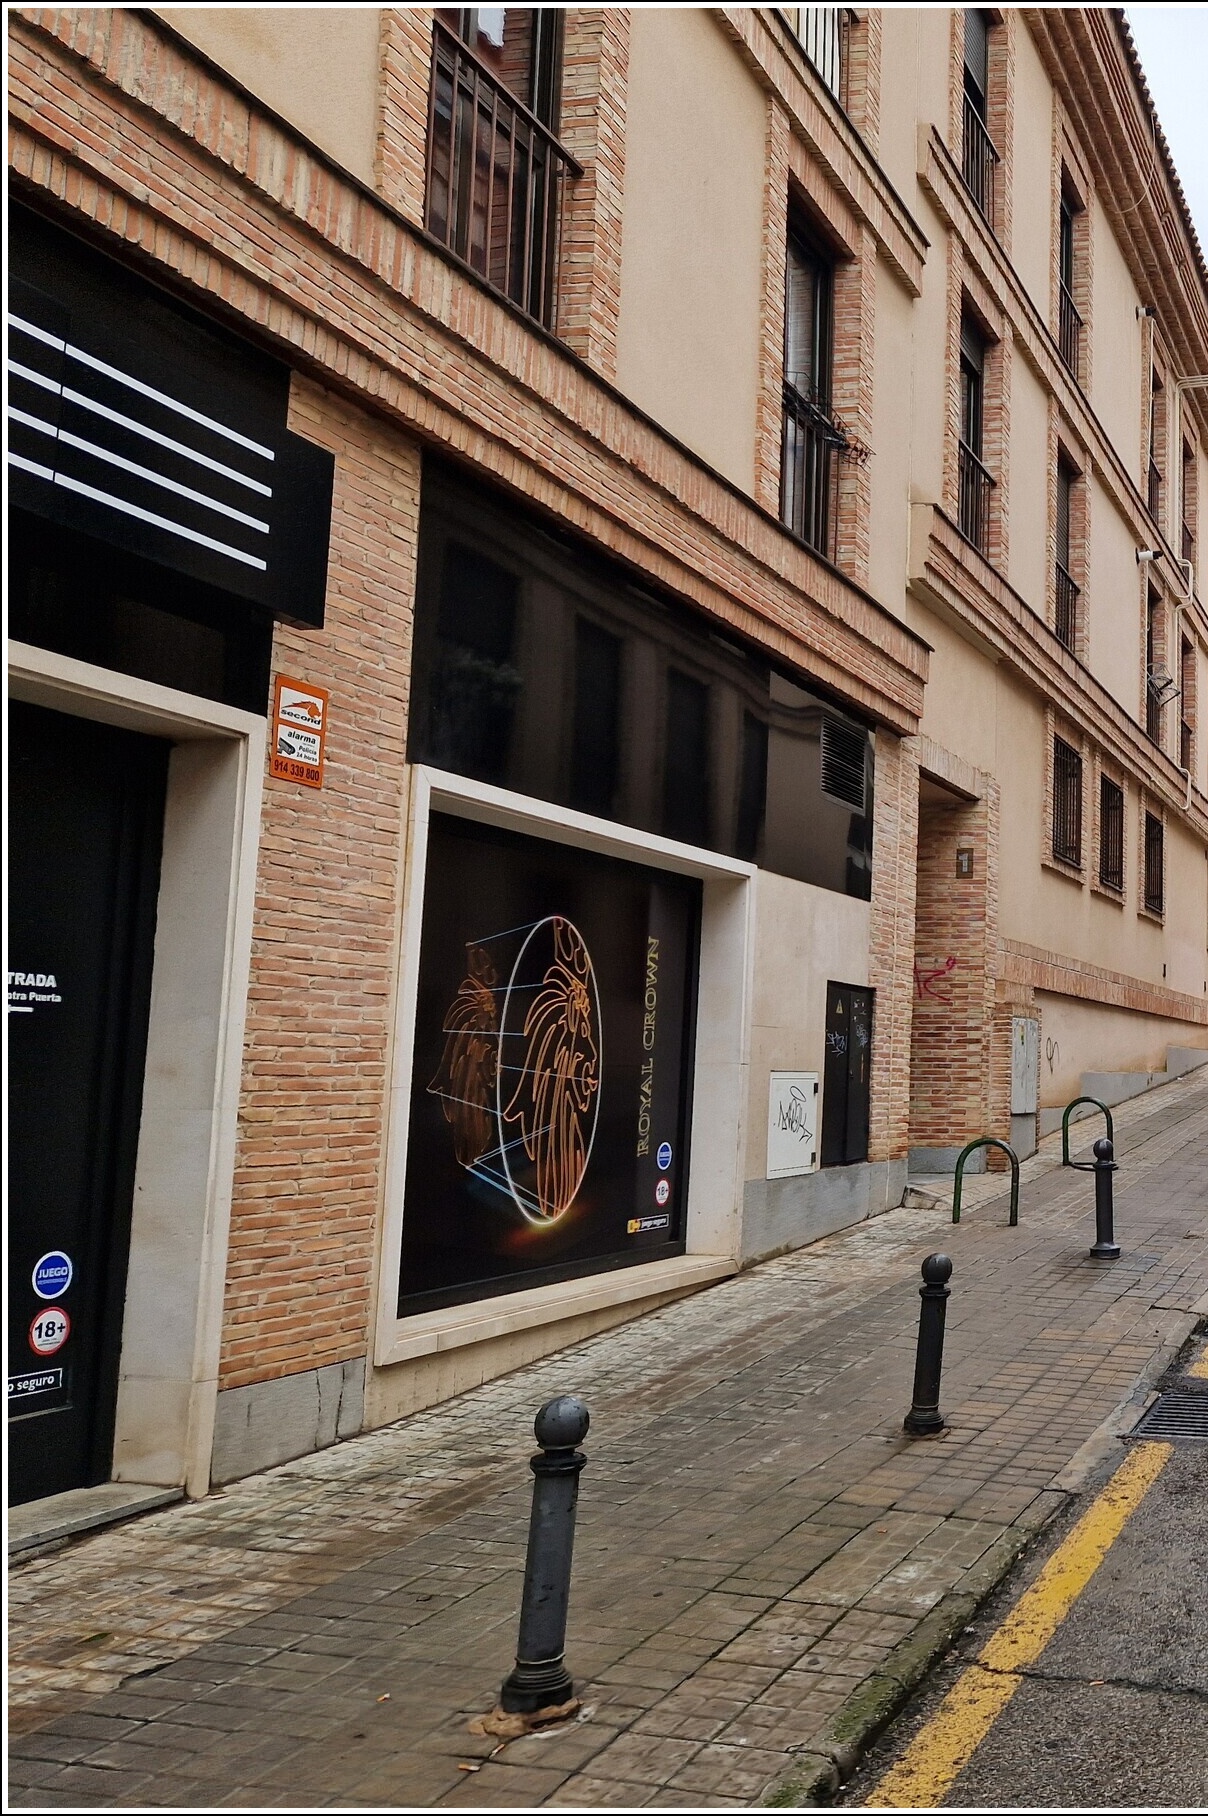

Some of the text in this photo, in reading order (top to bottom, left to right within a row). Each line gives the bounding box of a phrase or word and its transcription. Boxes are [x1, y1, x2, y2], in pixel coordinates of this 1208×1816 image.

[281, 709, 321, 725] second
[287, 731, 316, 744] alarma
[274, 759, 288, 773] 914
[290, 763, 304, 778] 339
[306, 768, 320, 782] 800
[8, 971, 57, 988] TRADA
[29, 991, 62, 1002] Puerta
[637, 936, 660, 1157] ROYAL CROWN
[37, 1266, 68, 1279] JUEGO
[34, 1321, 66, 1339] 18+
[17, 1375, 54, 1391] seguro
